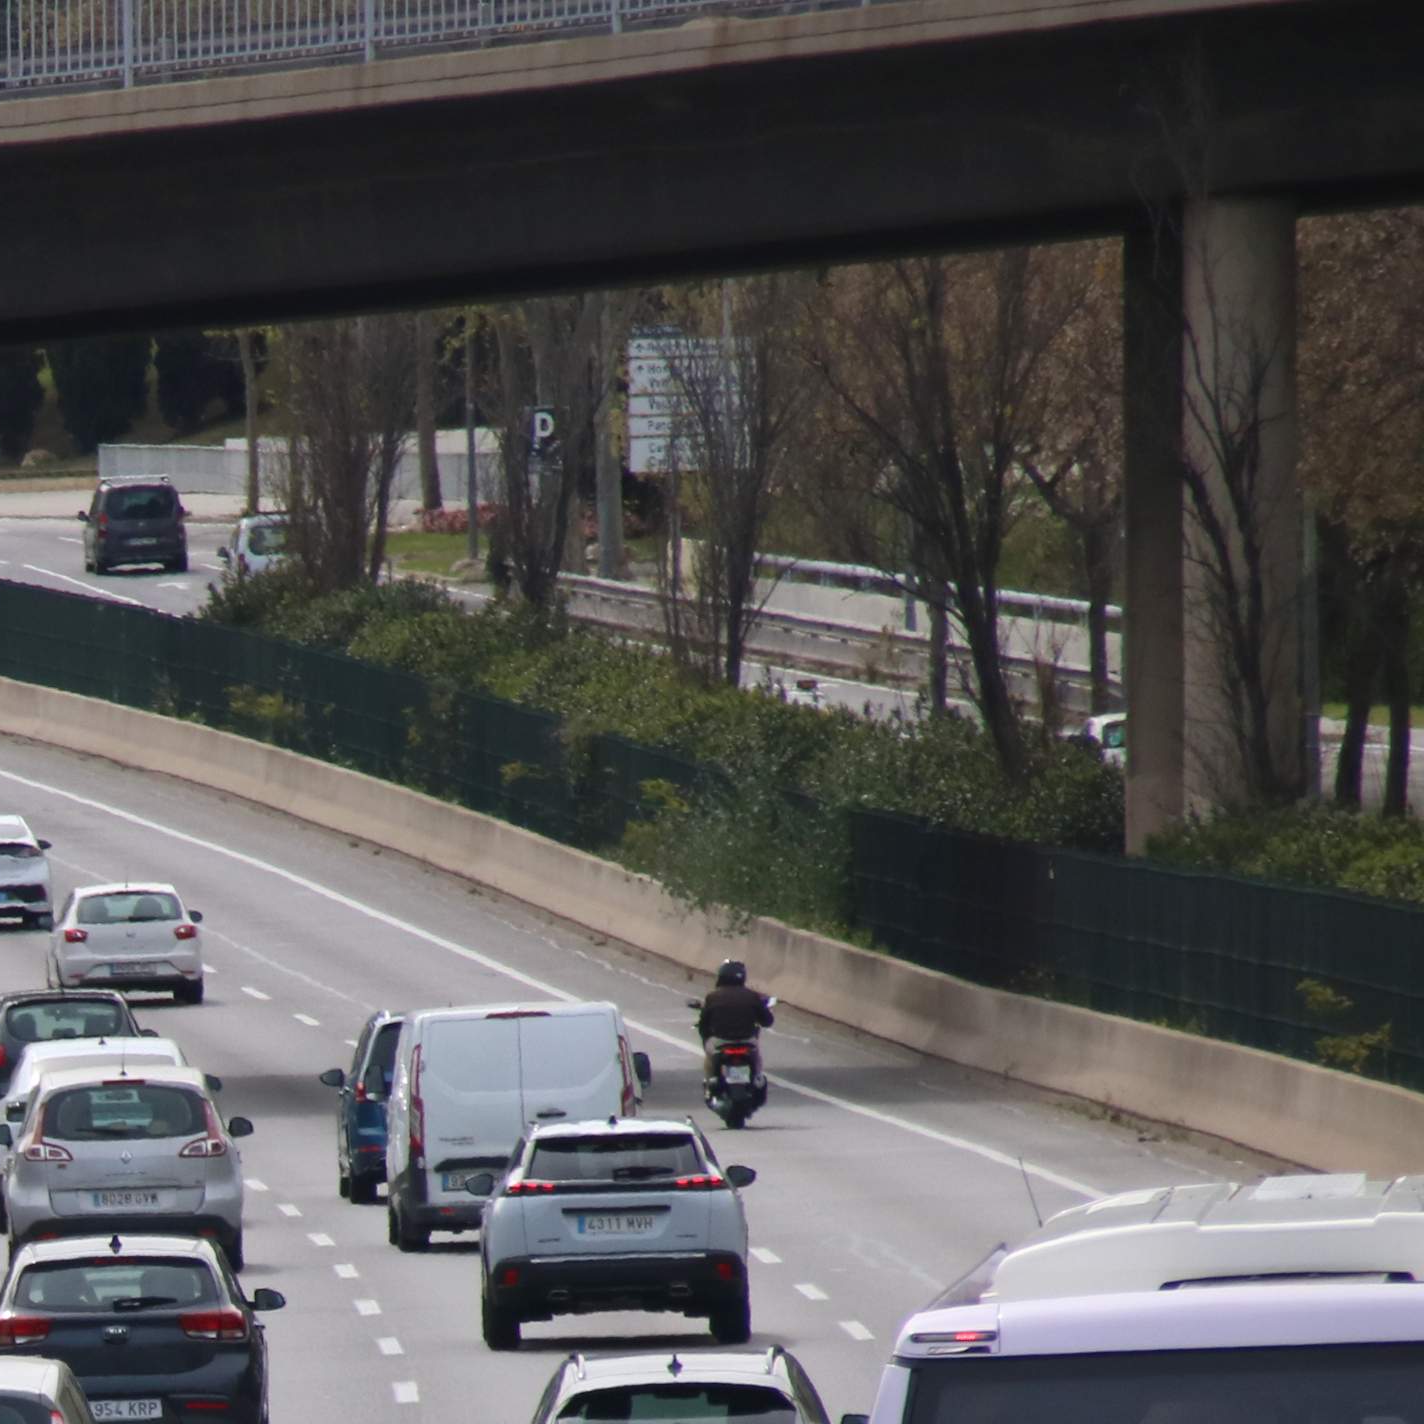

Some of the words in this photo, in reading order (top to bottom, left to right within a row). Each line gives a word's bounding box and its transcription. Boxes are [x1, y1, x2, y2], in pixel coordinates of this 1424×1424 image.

[588, 1216, 622, 1229] 4311
[93, 1402, 123, 1417] 954
[128, 1402, 158, 1416] KRP
